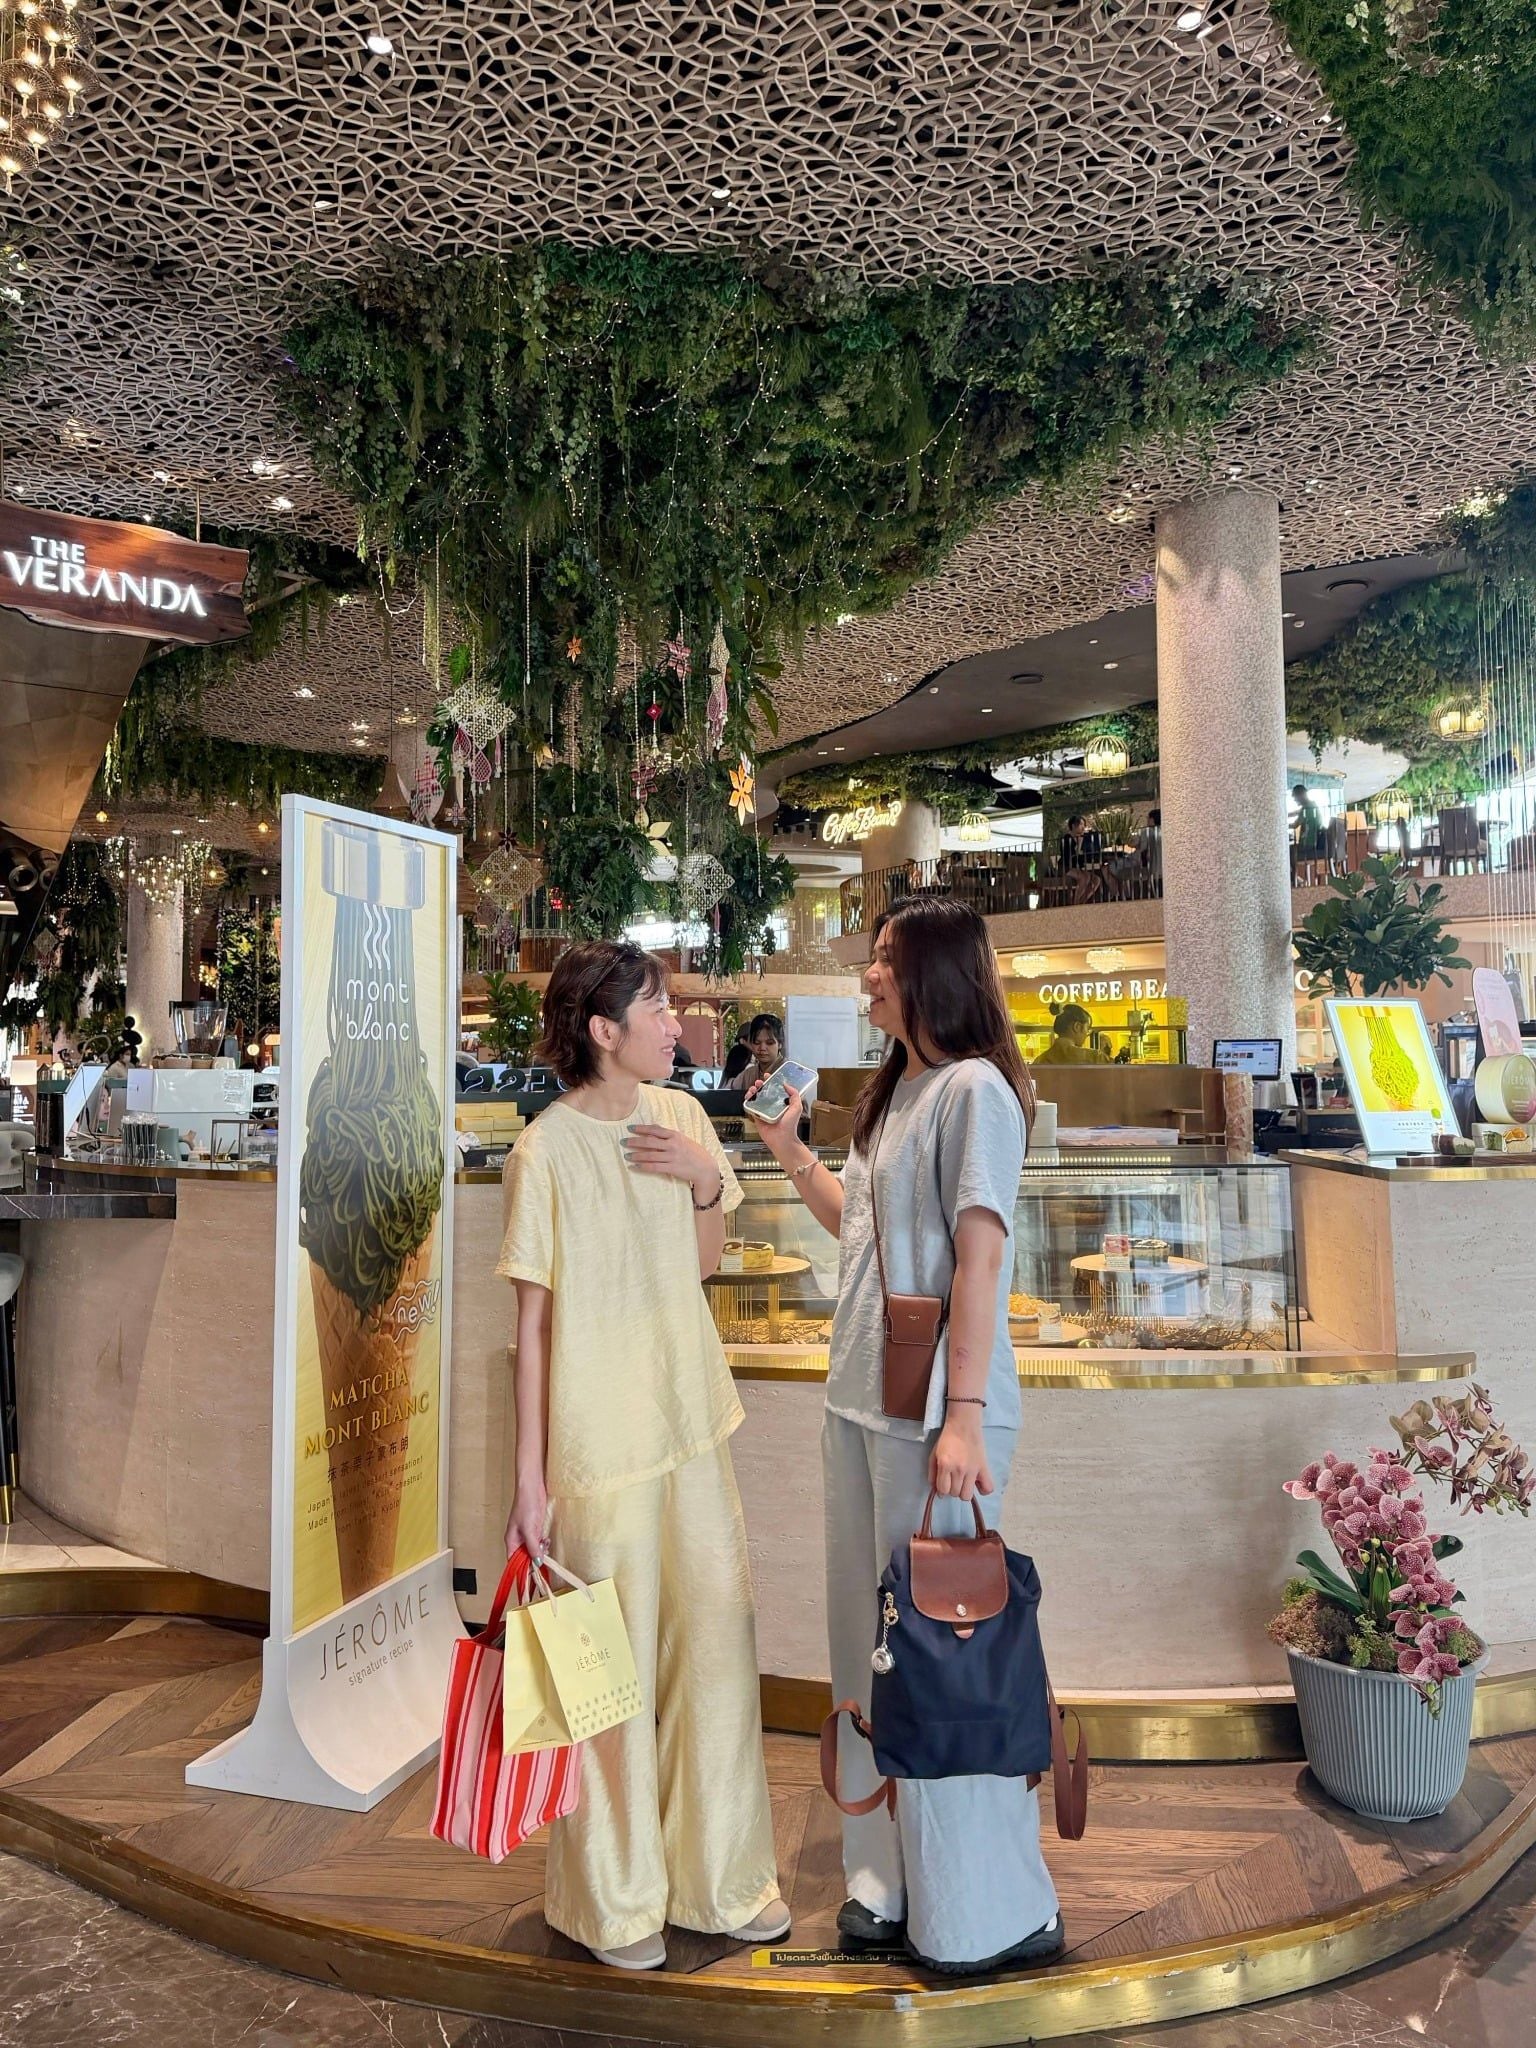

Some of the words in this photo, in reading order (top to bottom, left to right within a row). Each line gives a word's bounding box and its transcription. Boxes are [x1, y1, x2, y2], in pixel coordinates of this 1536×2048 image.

[31, 535, 85, 564] THE
[5, 551, 208, 617] VERANDA
[346, 978, 409, 1003] mont
[1039, 981, 1123, 1003] COFFEE
[346, 1002, 409, 1041] blanc
[397, 1280, 440, 1323] new!
[330, 1367, 408, 1410] MATCHA
[304, 1416, 363, 1459] MONT
[371, 1392, 429, 1432] BLANC
[308, 1515, 328, 1531] Made
[320, 1584, 429, 1680] JÉRÔME
[349, 1655, 388, 1687] signature
[389, 1638, 414, 1661] recipe
